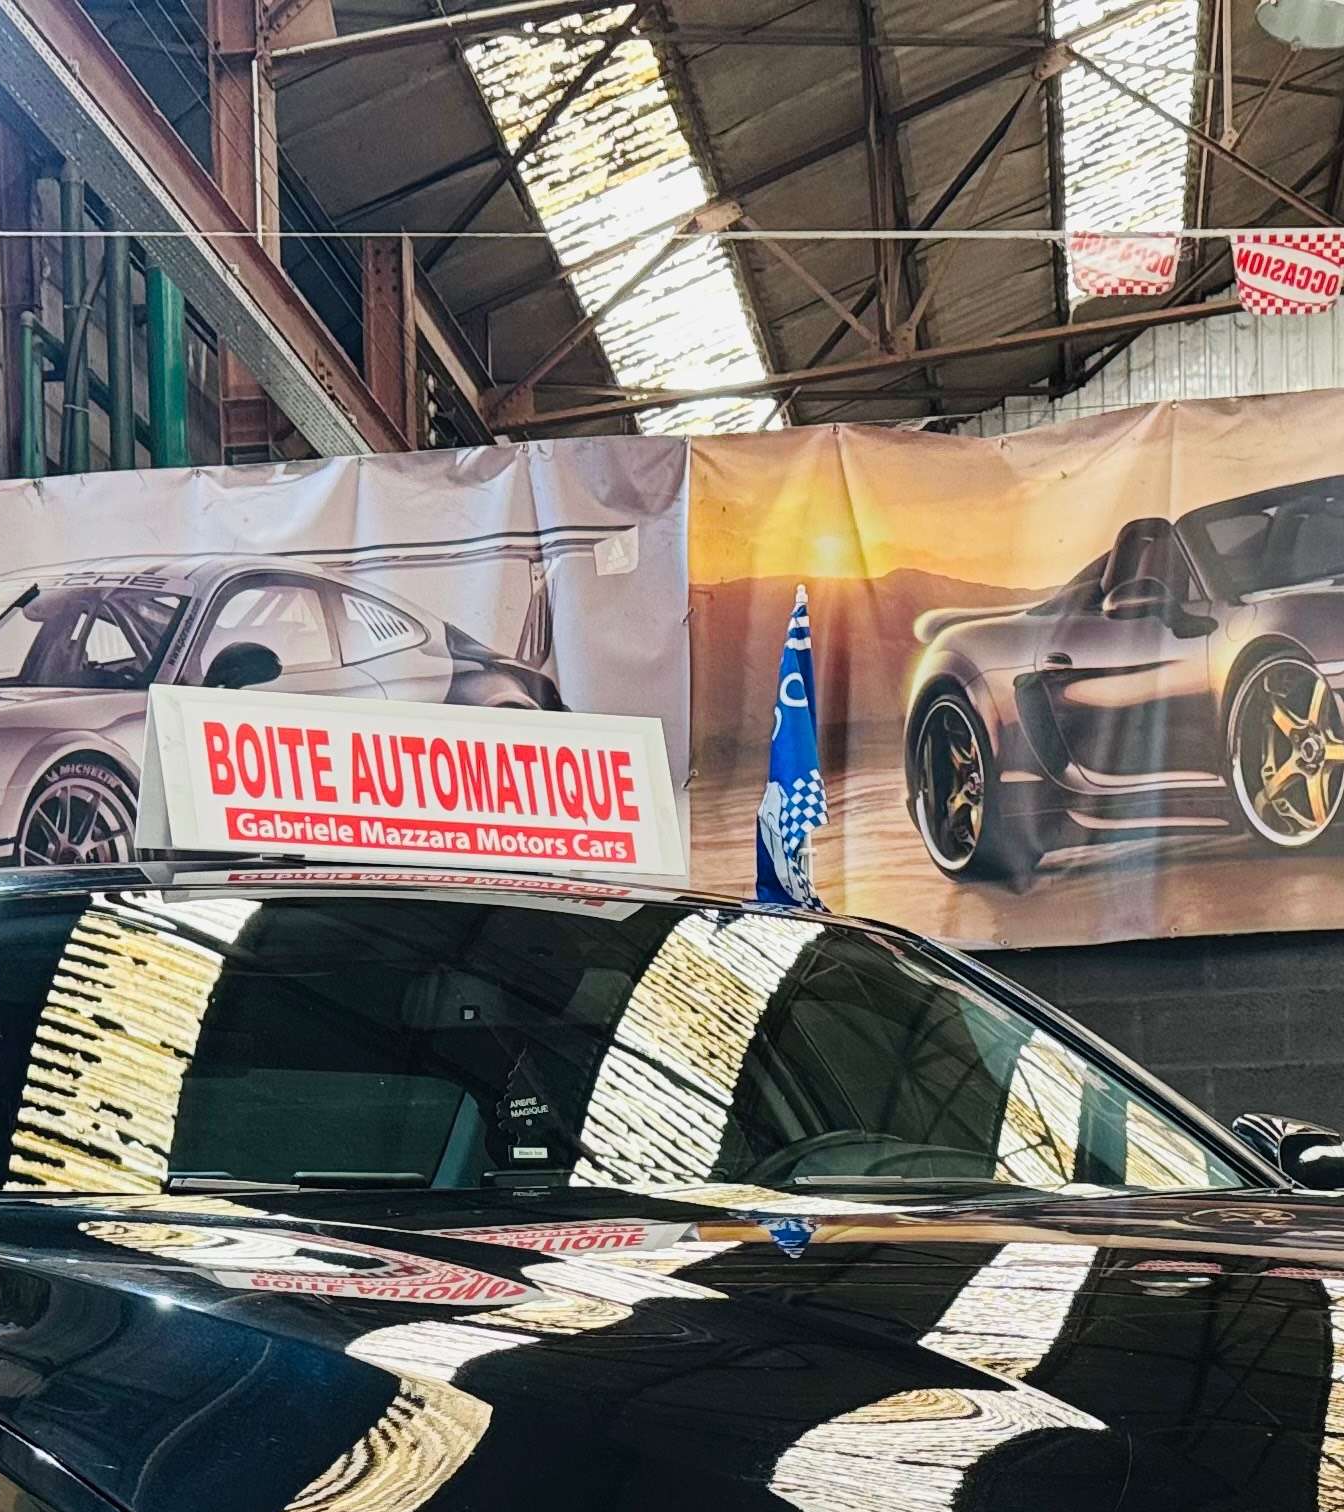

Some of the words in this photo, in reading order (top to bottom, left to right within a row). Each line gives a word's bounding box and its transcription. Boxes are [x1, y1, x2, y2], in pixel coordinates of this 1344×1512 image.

[59, 763, 119, 789] MICHELIN
[203, 721, 338, 802] BOITE
[351, 732, 641, 826] AUTOMATIQUE
[236, 812, 354, 844] Gabriele
[359, 821, 469, 850] Mazzara
[477, 827, 565, 857] Motors
[572, 834, 628, 860] Cars
